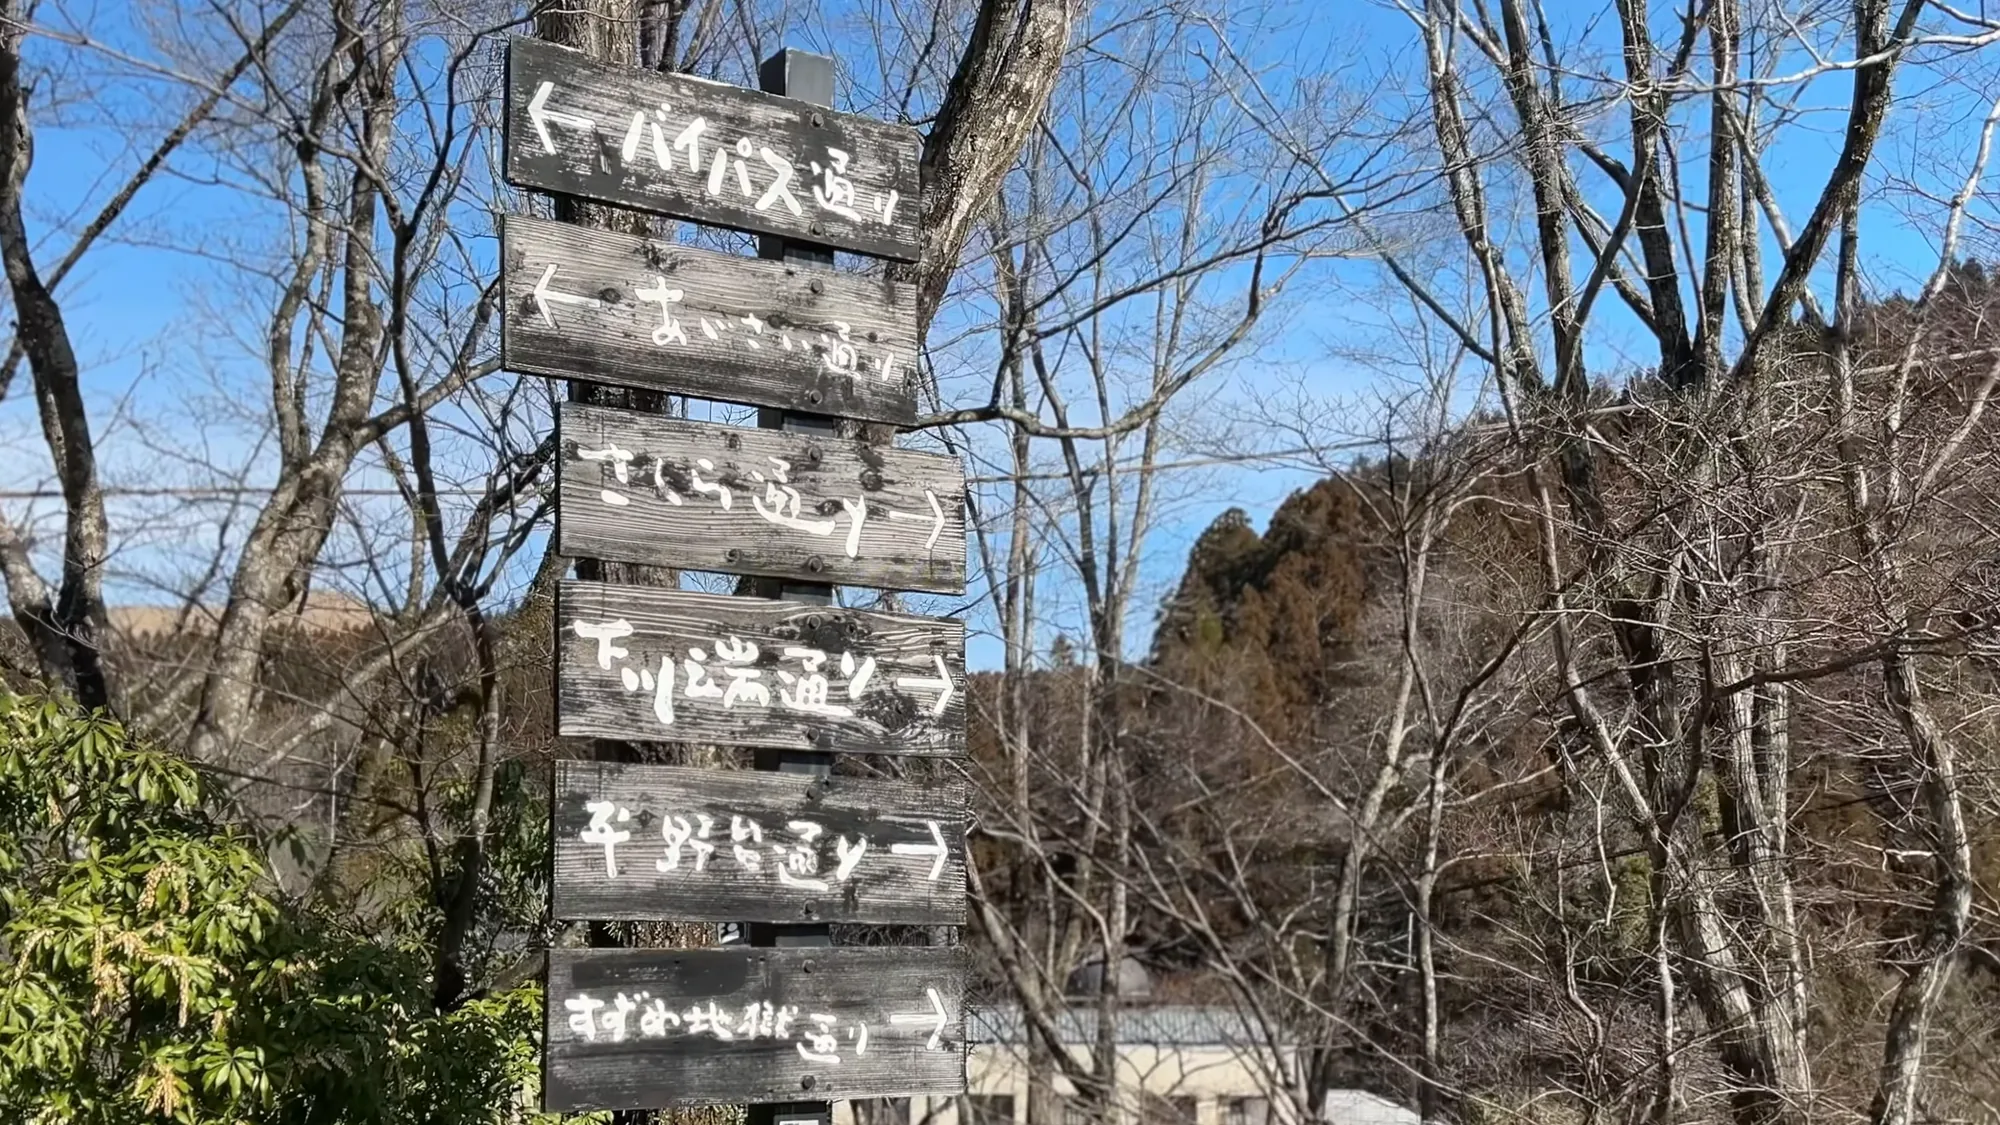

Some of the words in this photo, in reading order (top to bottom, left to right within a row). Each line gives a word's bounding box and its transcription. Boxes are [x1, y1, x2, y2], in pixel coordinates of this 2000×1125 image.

[622, 103, 899, 226] バイパス通り
[577, 442, 867, 559] さくら通り
